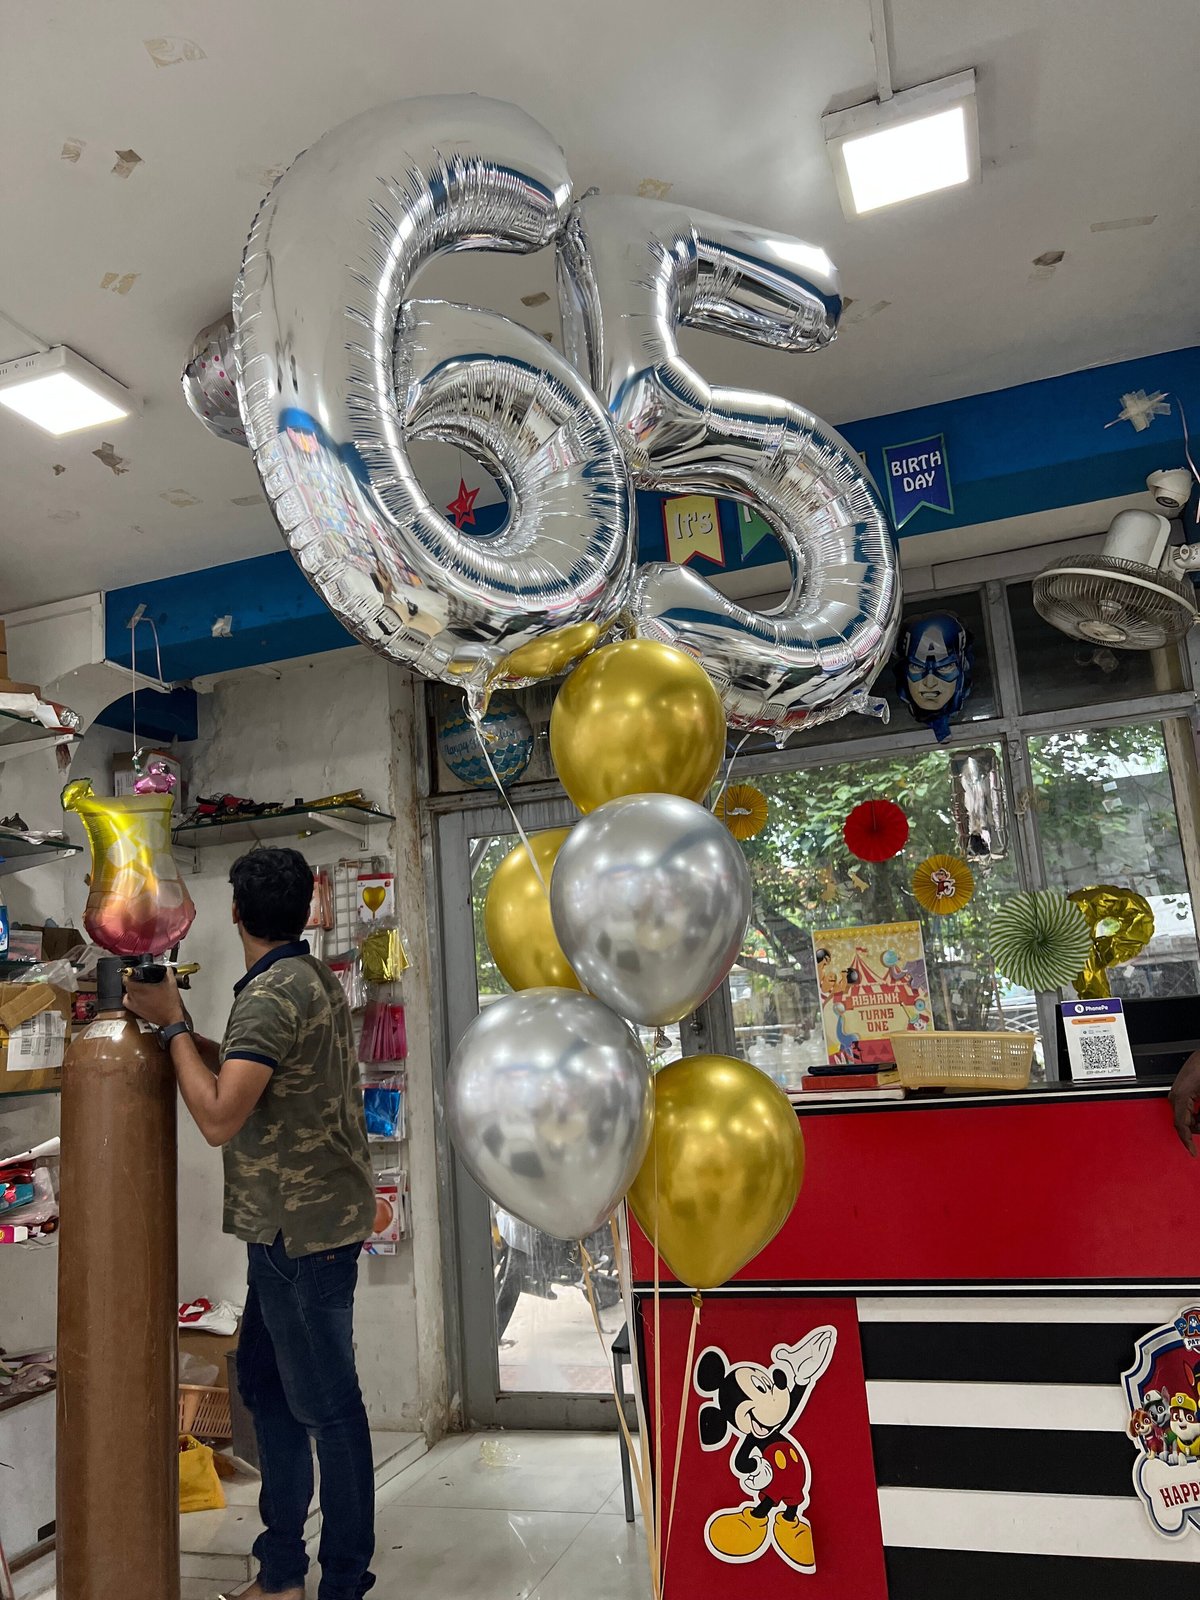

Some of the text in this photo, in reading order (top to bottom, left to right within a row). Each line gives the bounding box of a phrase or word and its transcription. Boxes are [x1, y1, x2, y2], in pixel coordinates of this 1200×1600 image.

[891, 451, 942, 477] BIRTH
[903, 471, 936, 493] DAY
[851, 992, 900, 1006] RISHANK
[859, 1008, 894, 1021] TURNS
[866, 1020, 889, 1032] ONE
[1173, 1314, 1200, 1337] PA
[1187, 1338, 1200, 1347] PAT
[1159, 1481, 1200, 1508] HAPP
